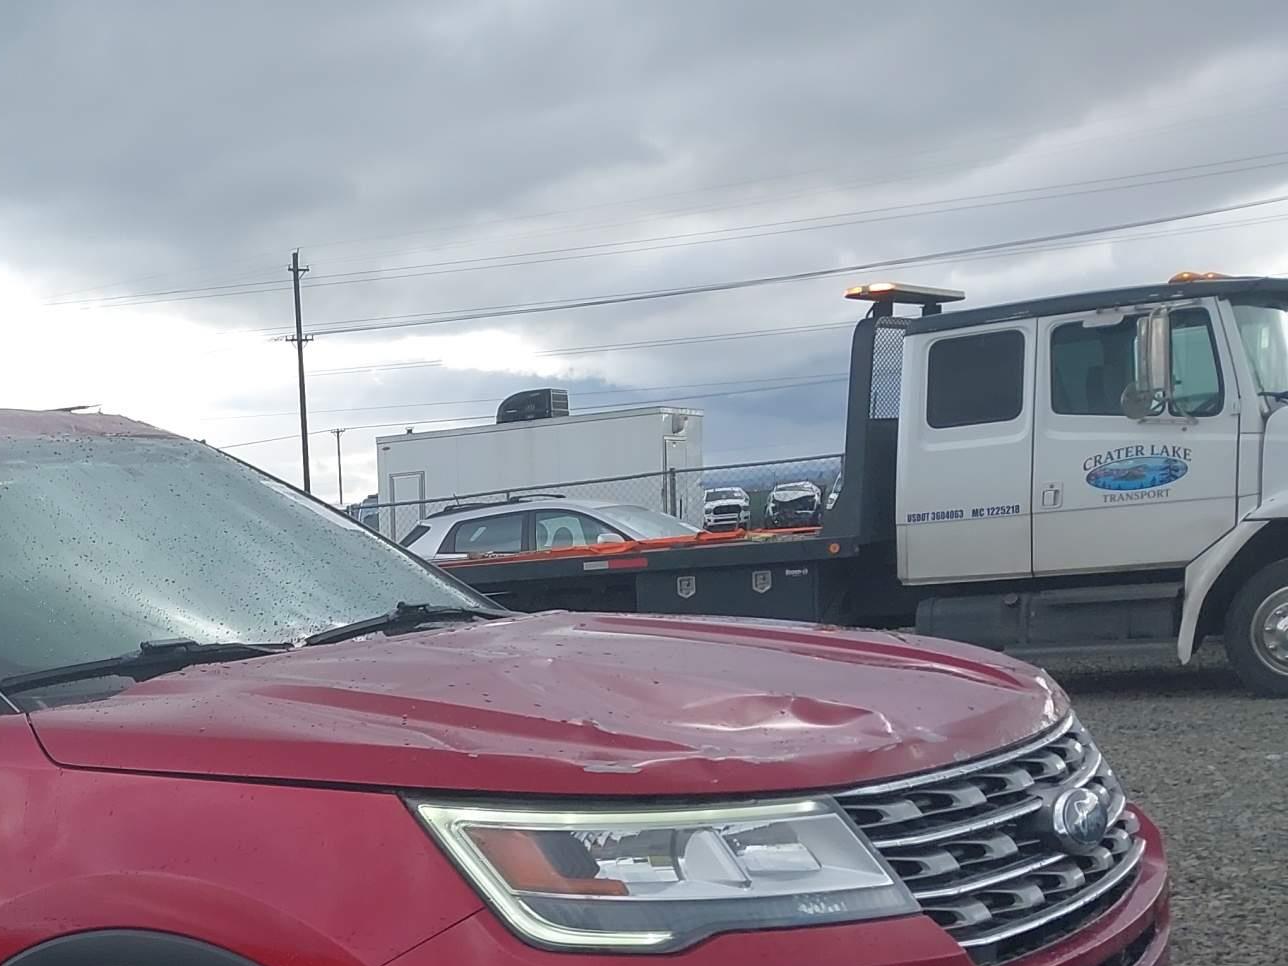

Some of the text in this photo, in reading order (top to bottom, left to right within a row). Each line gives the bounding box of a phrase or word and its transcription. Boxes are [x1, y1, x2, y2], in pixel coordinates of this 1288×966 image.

[1083, 444, 1192, 471] CRATER LAKE
[1102, 488, 1171, 503] TRANSPORT
[907, 512, 930, 523] USDOT
[972, 508, 985, 518] MC
